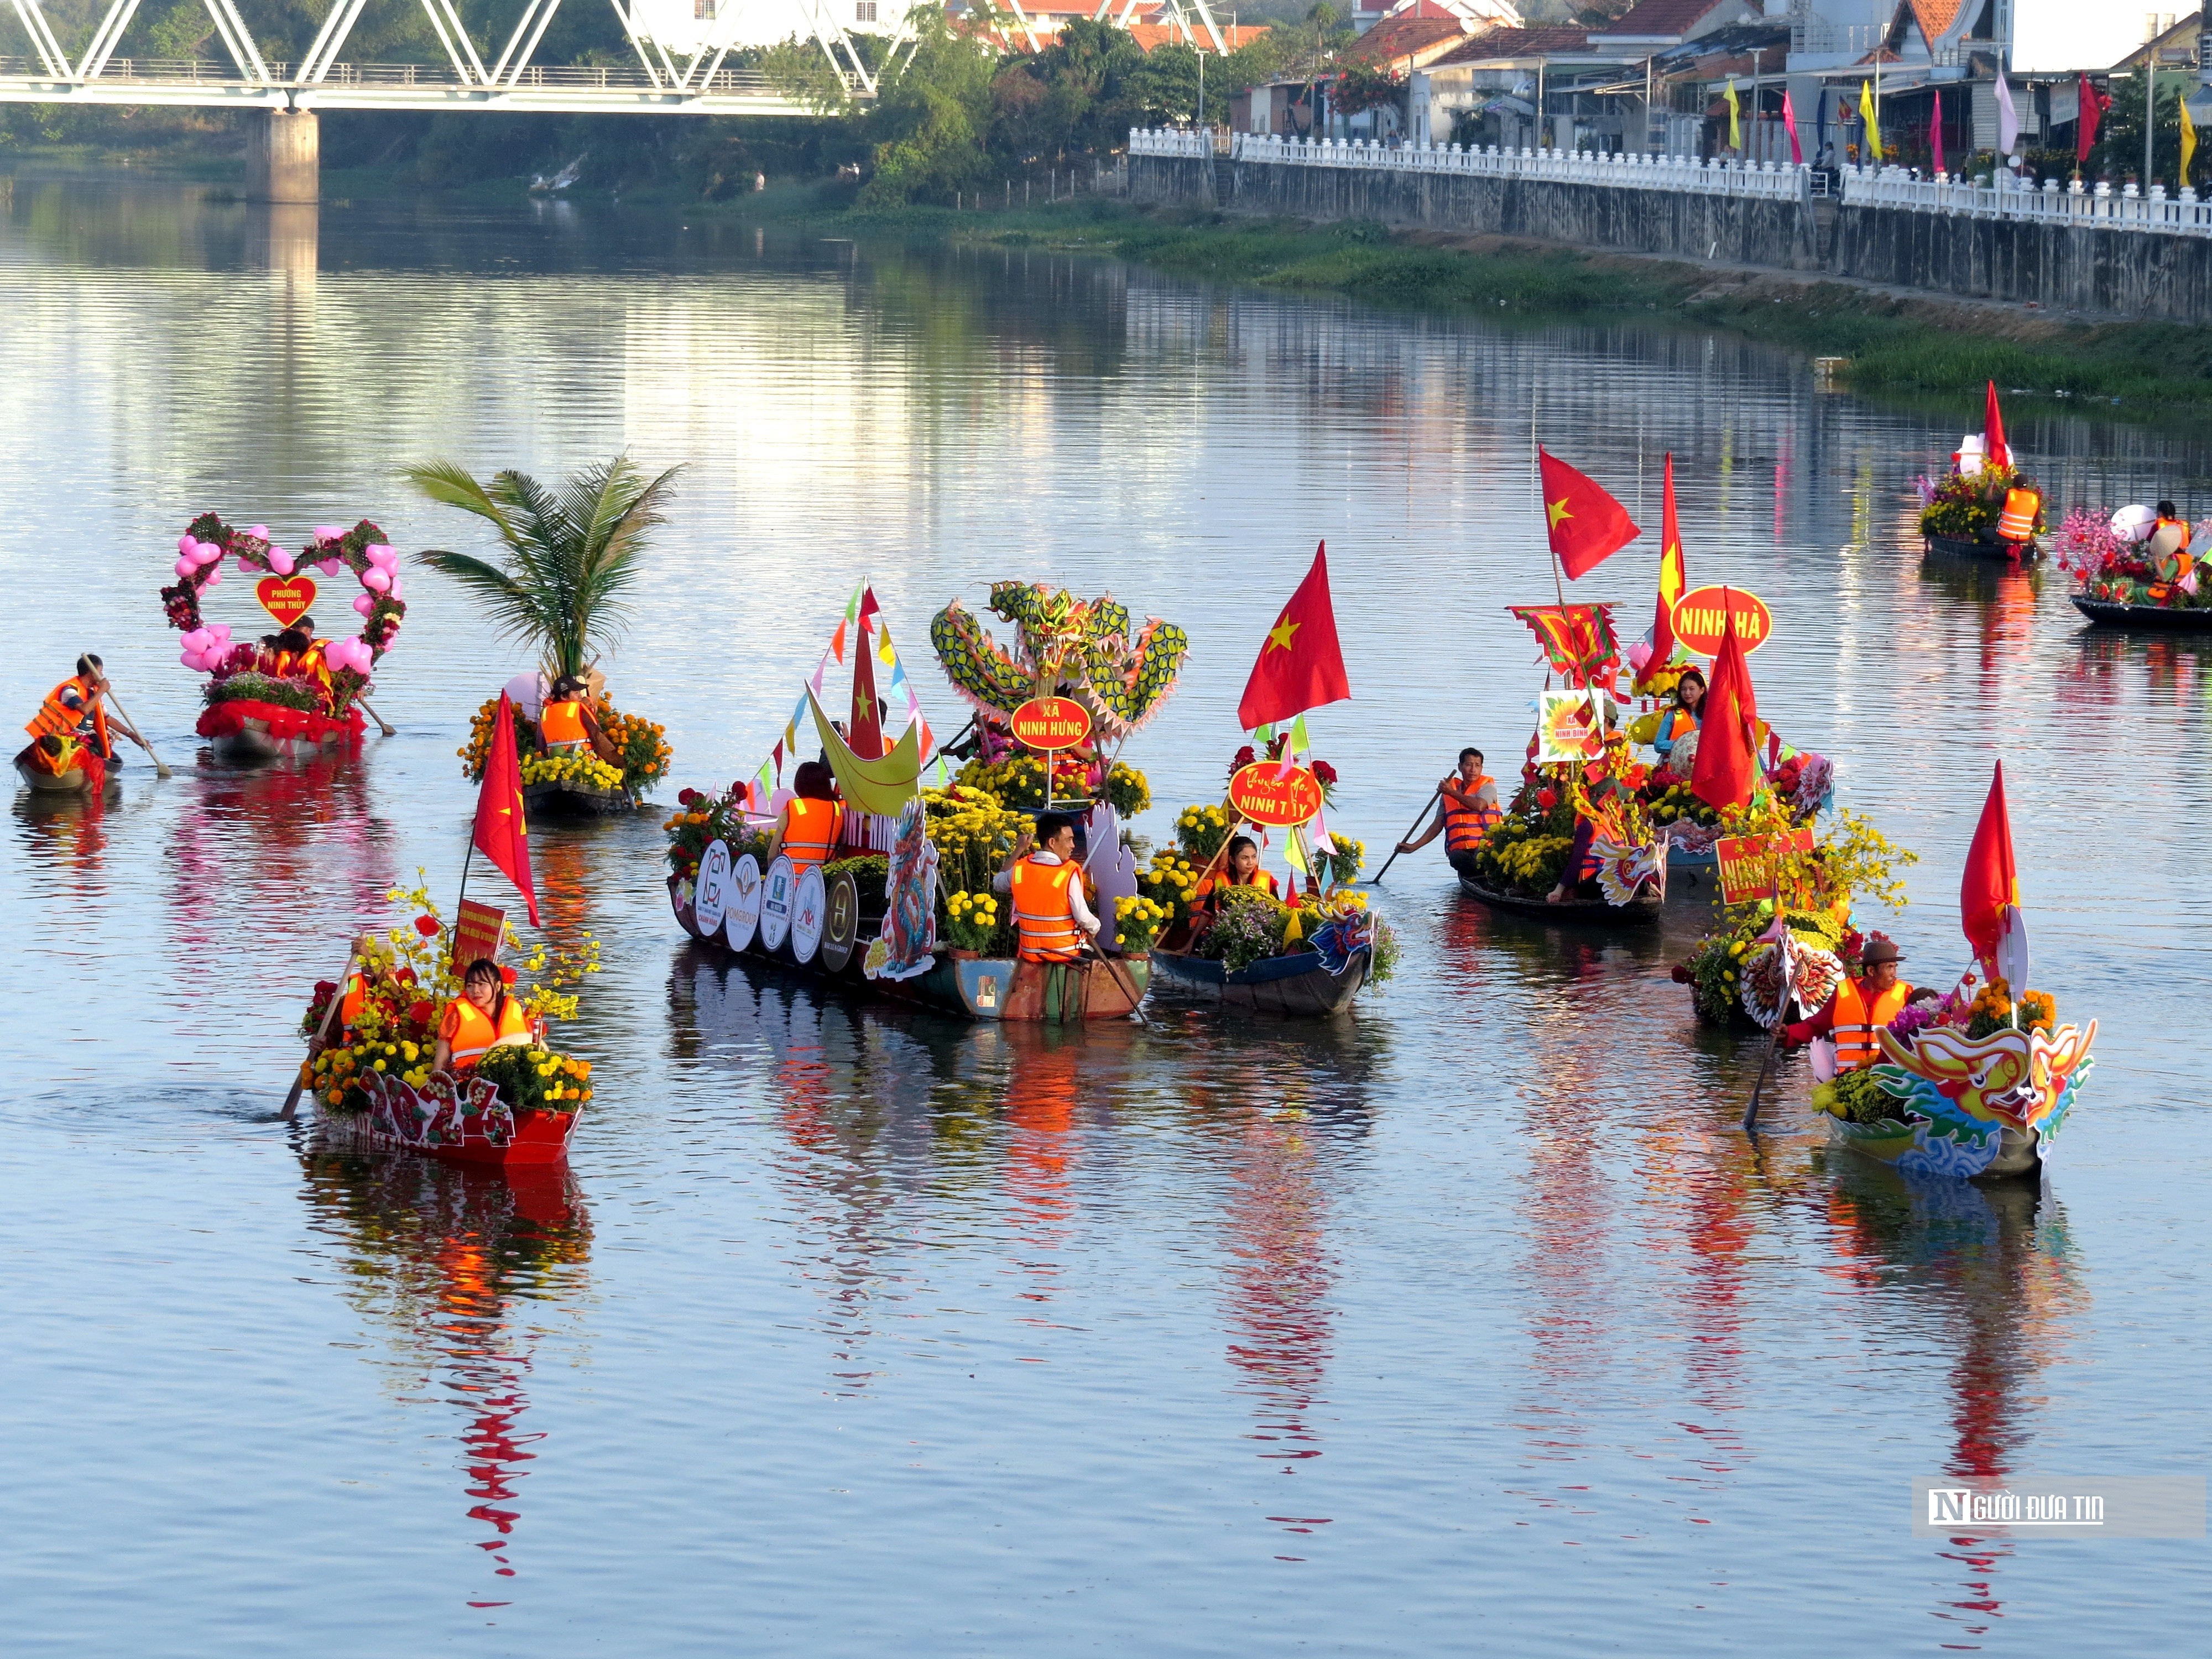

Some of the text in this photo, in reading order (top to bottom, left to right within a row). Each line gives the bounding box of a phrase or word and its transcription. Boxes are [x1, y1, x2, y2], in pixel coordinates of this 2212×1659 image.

[272, 588, 301, 598] PHƯỜNG
[1679, 604, 1760, 639] NINH HÀ
[1042, 702, 1060, 717] XÃ
[1019, 719, 1082, 736] NINH HƯNG
[1555, 728, 1588, 738] NINH BÌNH
[1240, 795, 1276, 813] NINH
[869, 813, 901, 852] NIN
